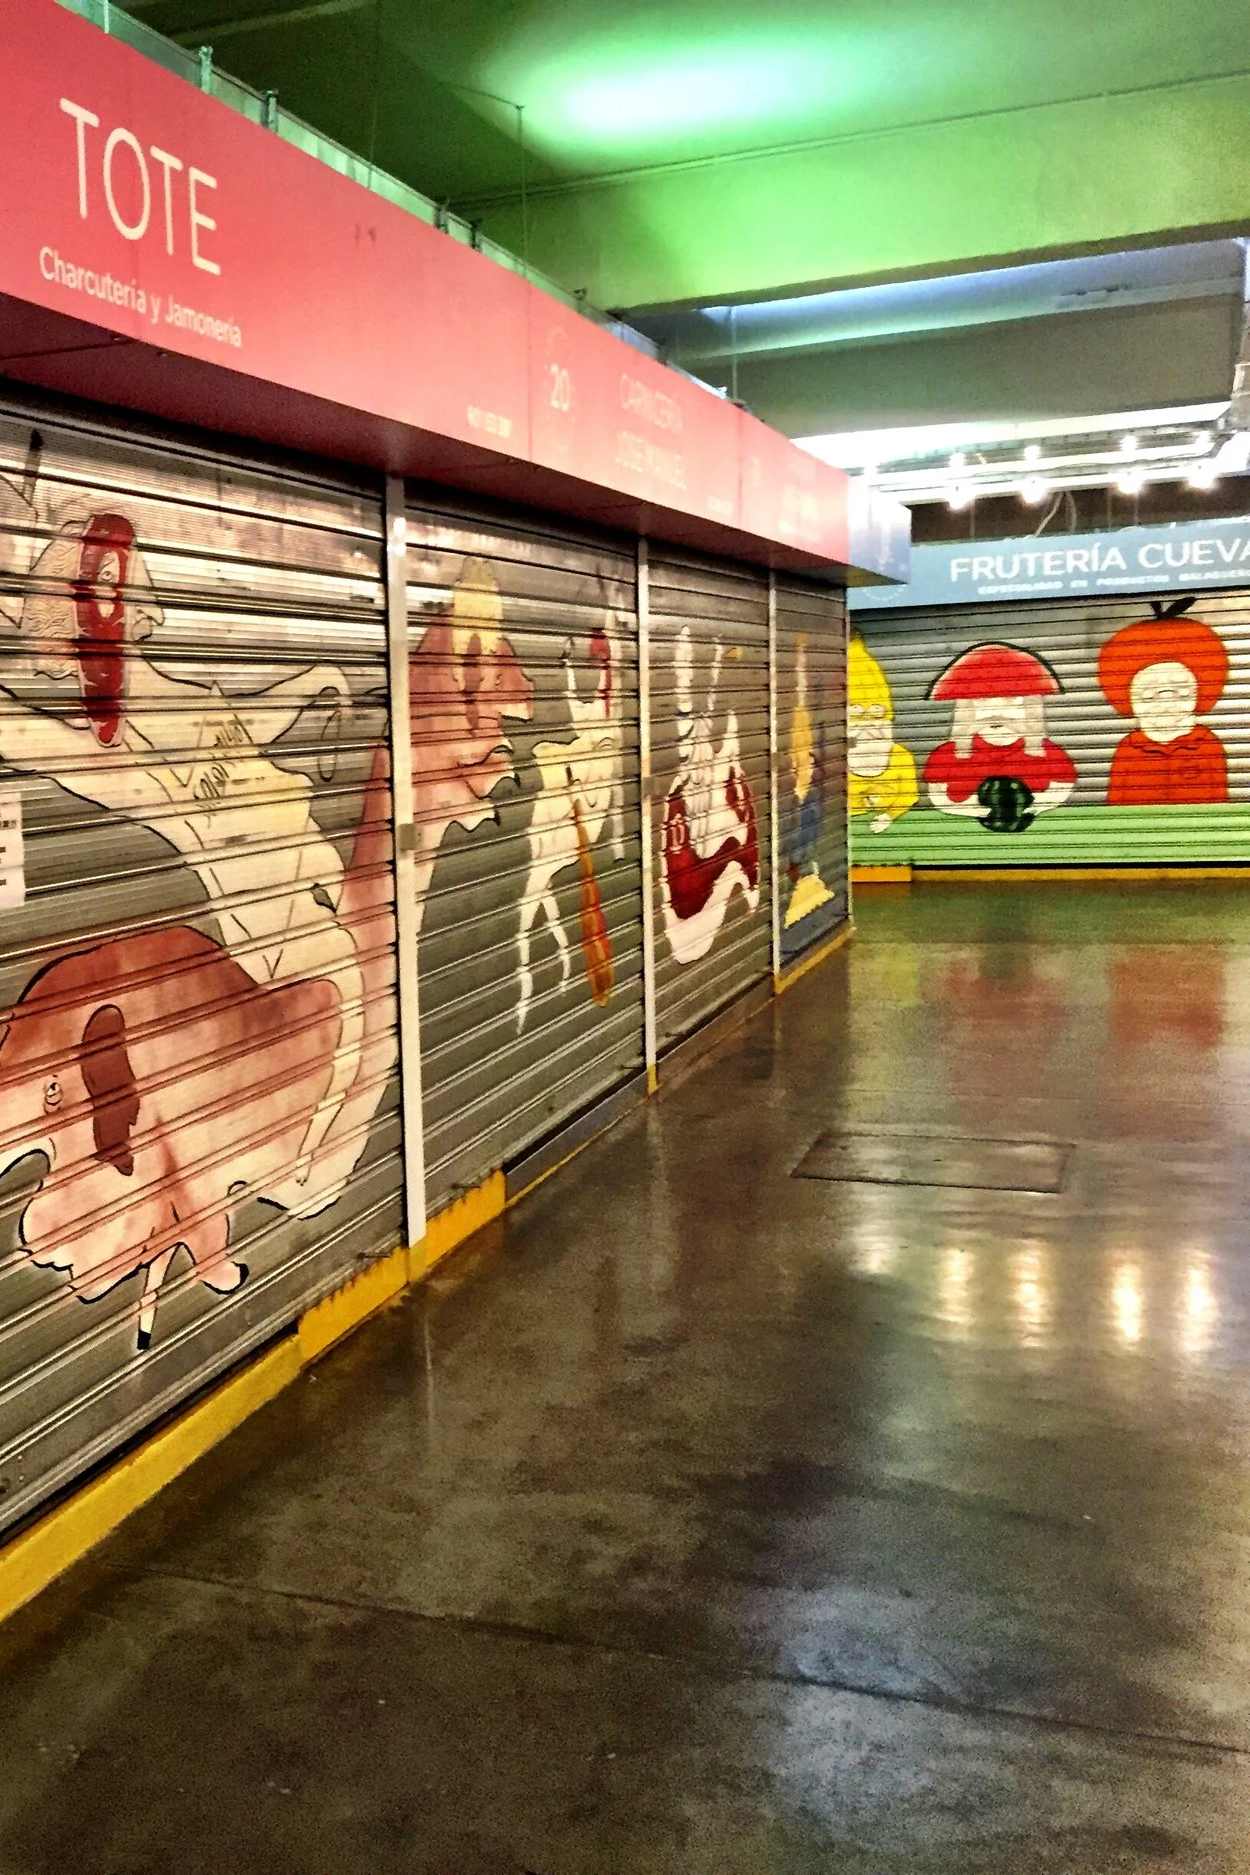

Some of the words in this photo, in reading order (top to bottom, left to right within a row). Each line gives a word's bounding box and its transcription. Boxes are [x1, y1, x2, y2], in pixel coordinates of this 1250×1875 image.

[59, 97, 221, 276] TOTE
[39, 246, 147, 315] Charcutería
[149, 297, 162, 325] y
[551, 363, 572, 412] 20
[949, 541, 1128, 582] FRUTERÍA
